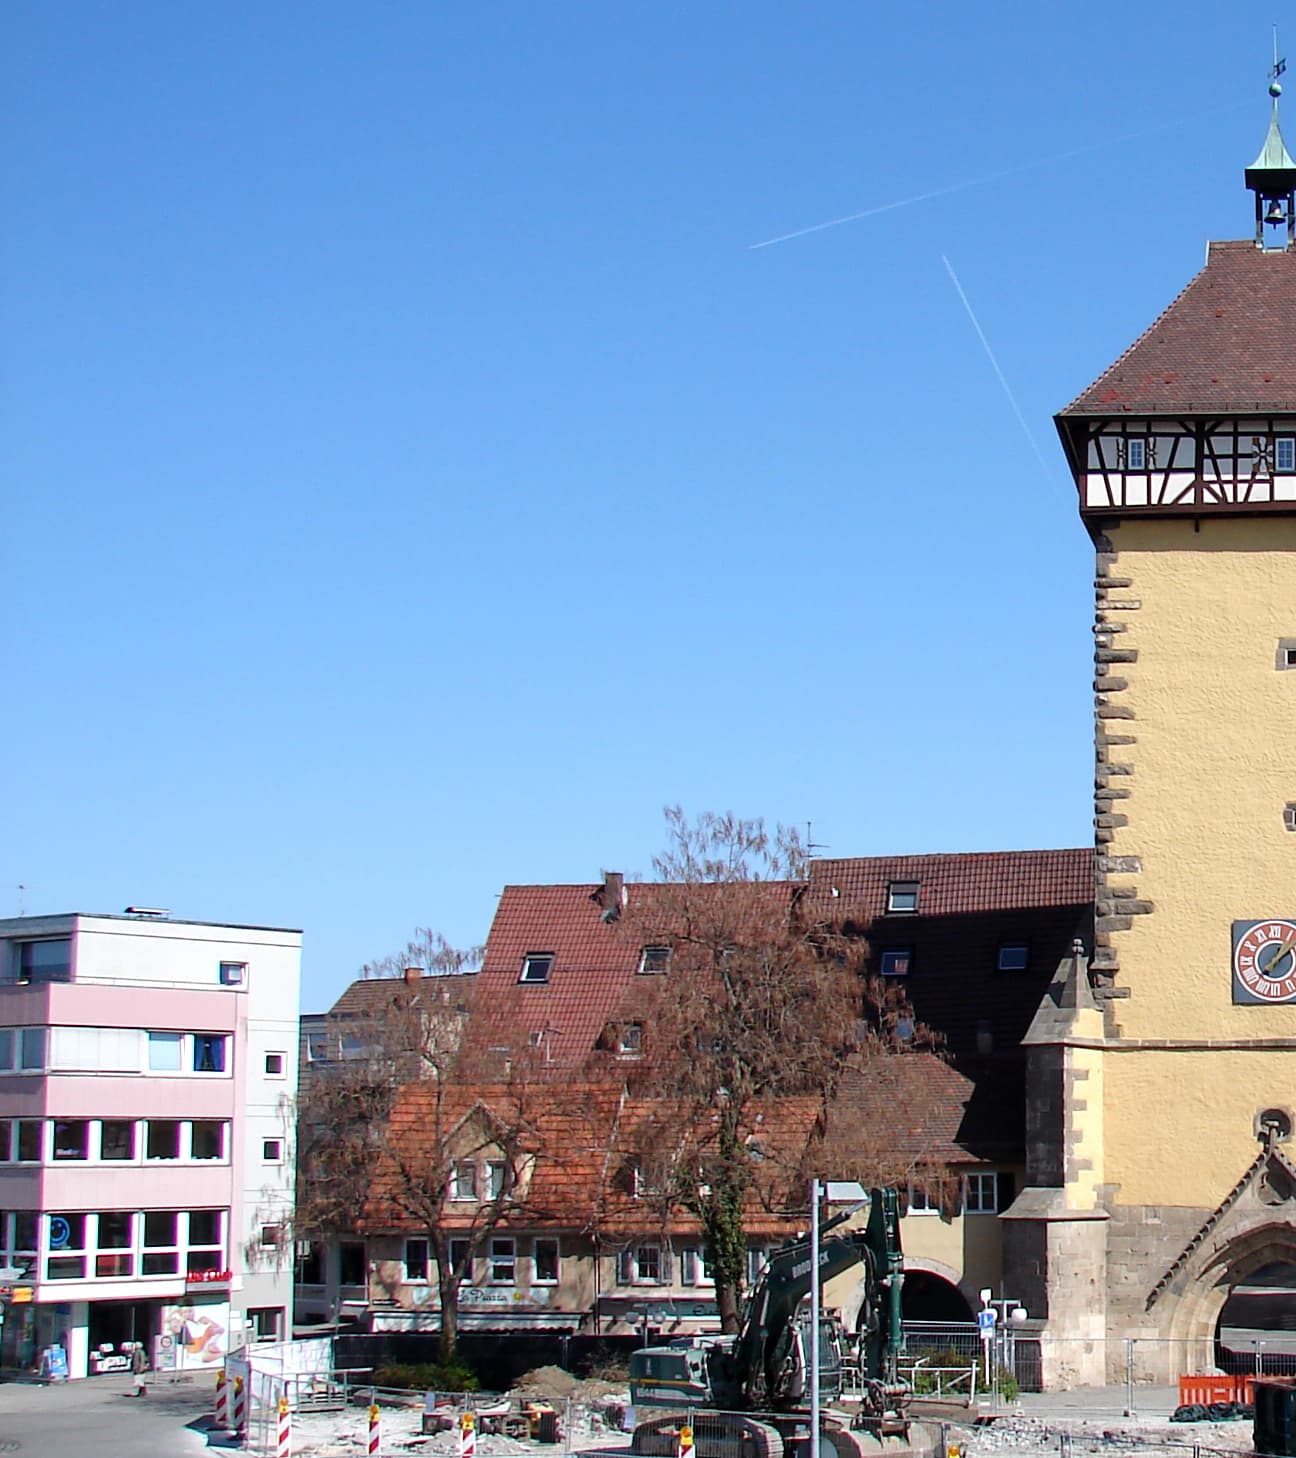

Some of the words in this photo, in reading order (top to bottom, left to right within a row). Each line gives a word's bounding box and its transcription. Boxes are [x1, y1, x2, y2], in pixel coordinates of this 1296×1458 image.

[1254, 929, 1268, 943] XI
[1269, 925, 1281, 938] XII
[1286, 930, 1293, 941] I
[1243, 940, 1257, 952] X
[1240, 955, 1253, 965] IX
[791, 1251, 830, 1279] BRODCK
